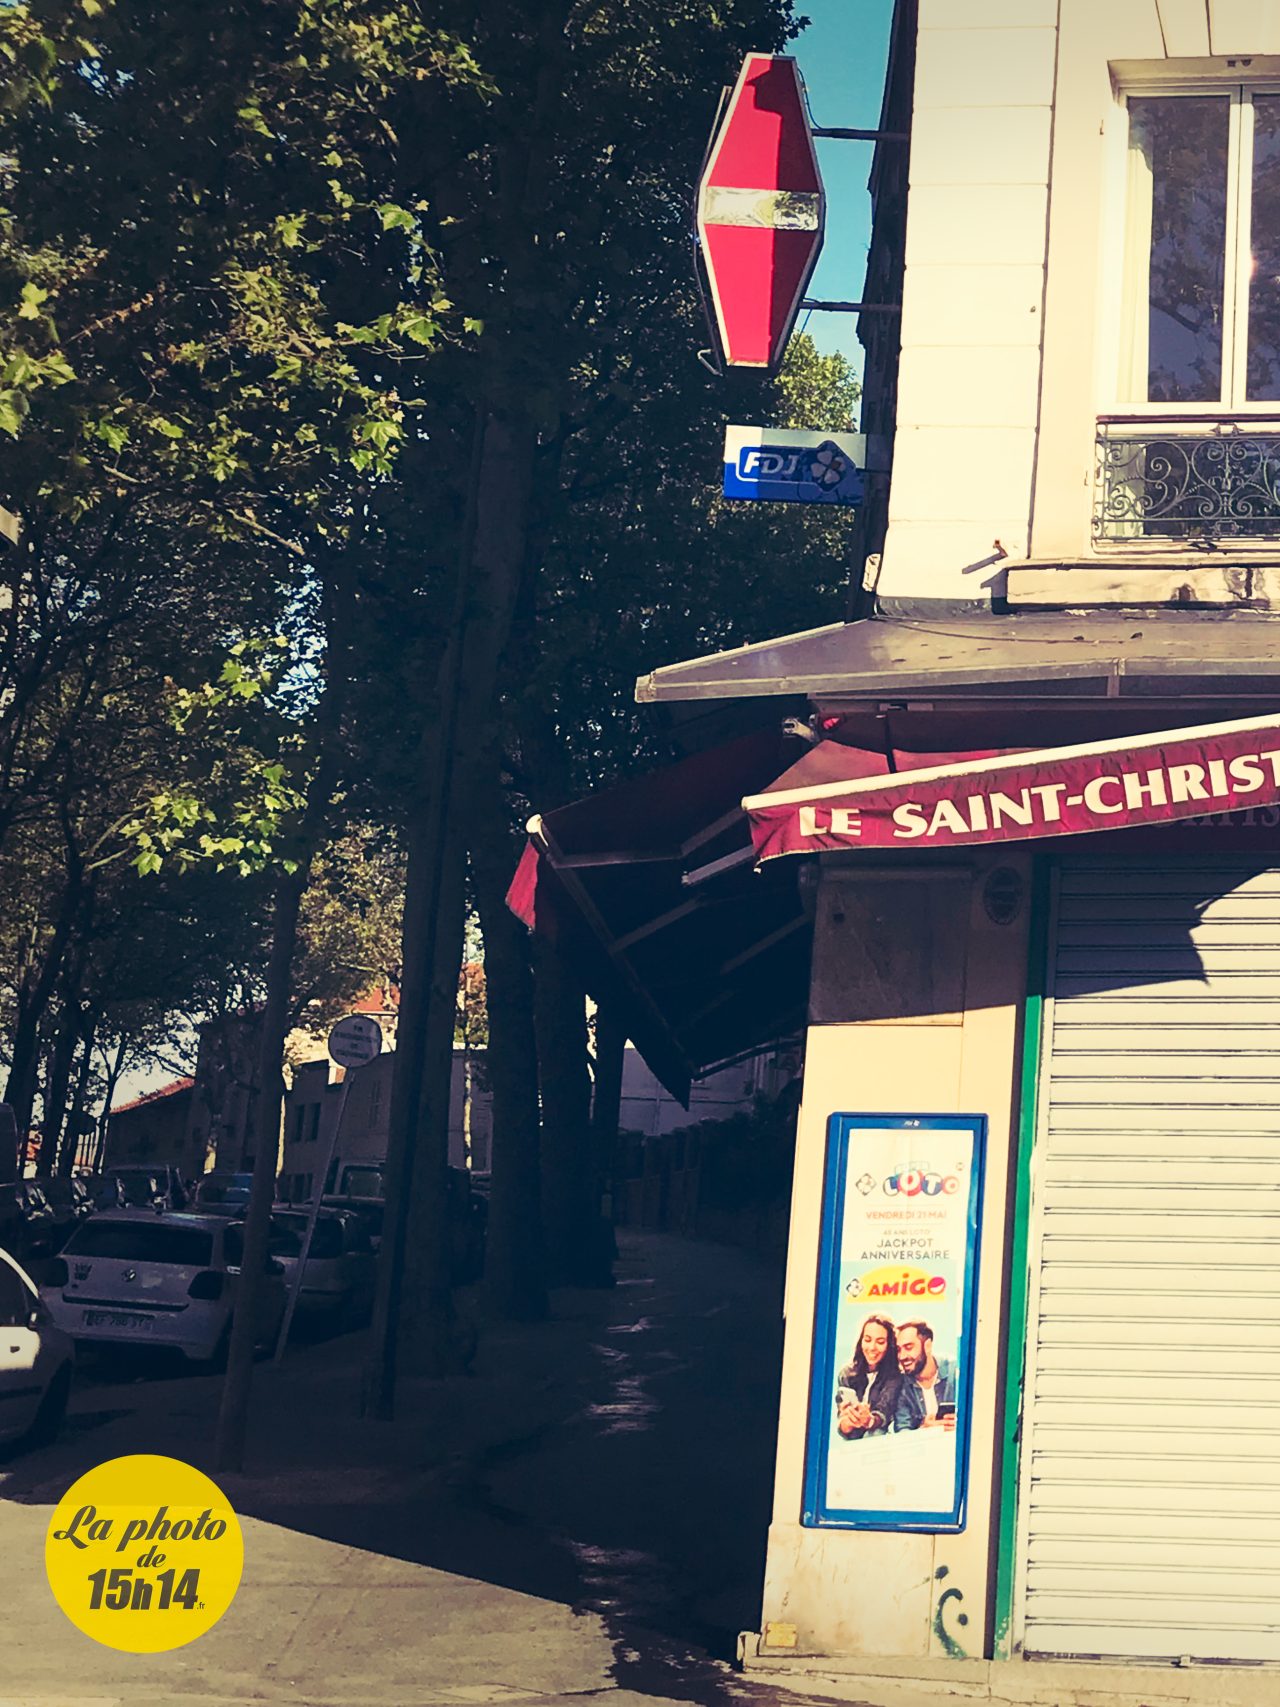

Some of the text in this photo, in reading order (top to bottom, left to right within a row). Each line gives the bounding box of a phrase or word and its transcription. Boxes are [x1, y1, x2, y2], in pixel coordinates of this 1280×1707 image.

[743, 451, 801, 475] FDJ
[799, 806, 862, 837] LE
[883, 1170, 960, 1197] LOTO
[866, 1210, 947, 1220] VENDREDI 21 MAI
[877, 1238, 934, 1248] JACKPOT
[861, 1250, 950, 1260] ANNIVERSAIRE
